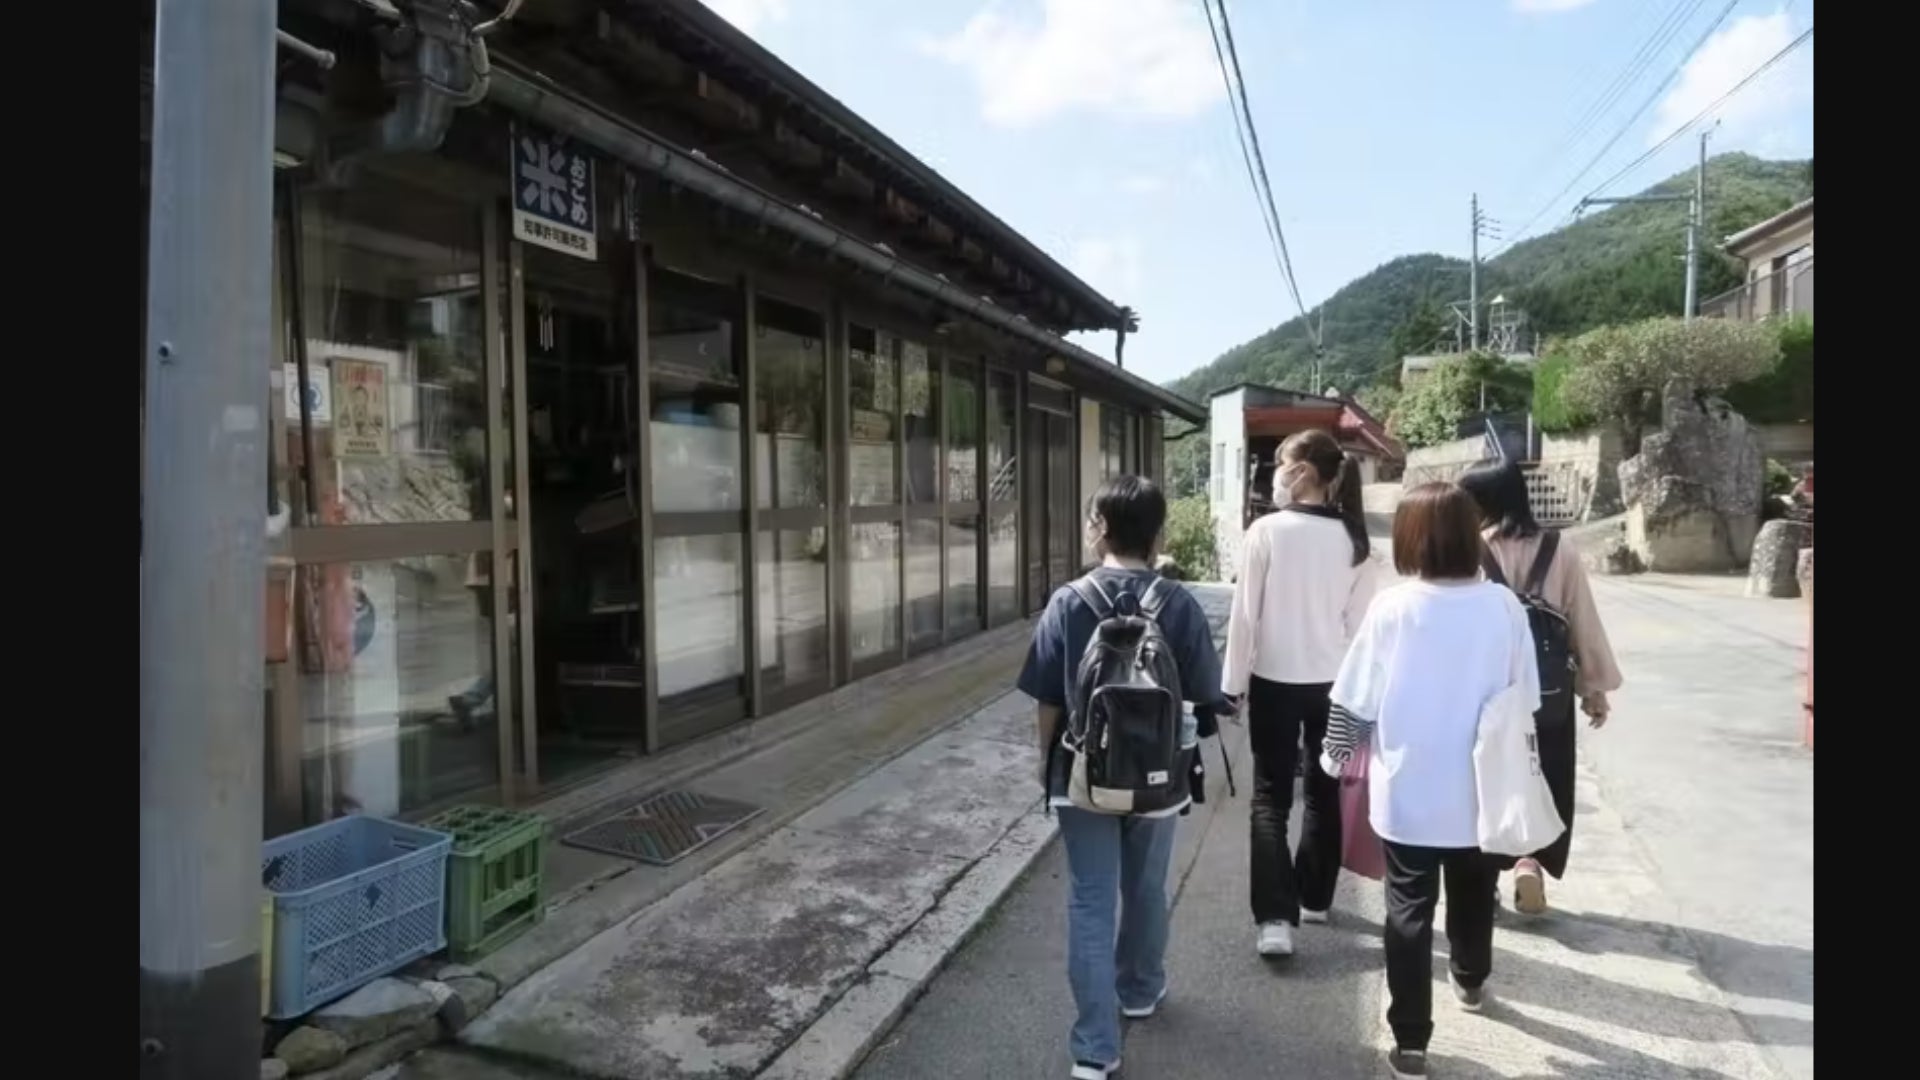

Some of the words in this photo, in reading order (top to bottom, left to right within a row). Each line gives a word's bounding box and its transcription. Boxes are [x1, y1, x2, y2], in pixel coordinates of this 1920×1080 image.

[521, 136, 567, 216] 米
[570, 155, 588, 225] おこめ
